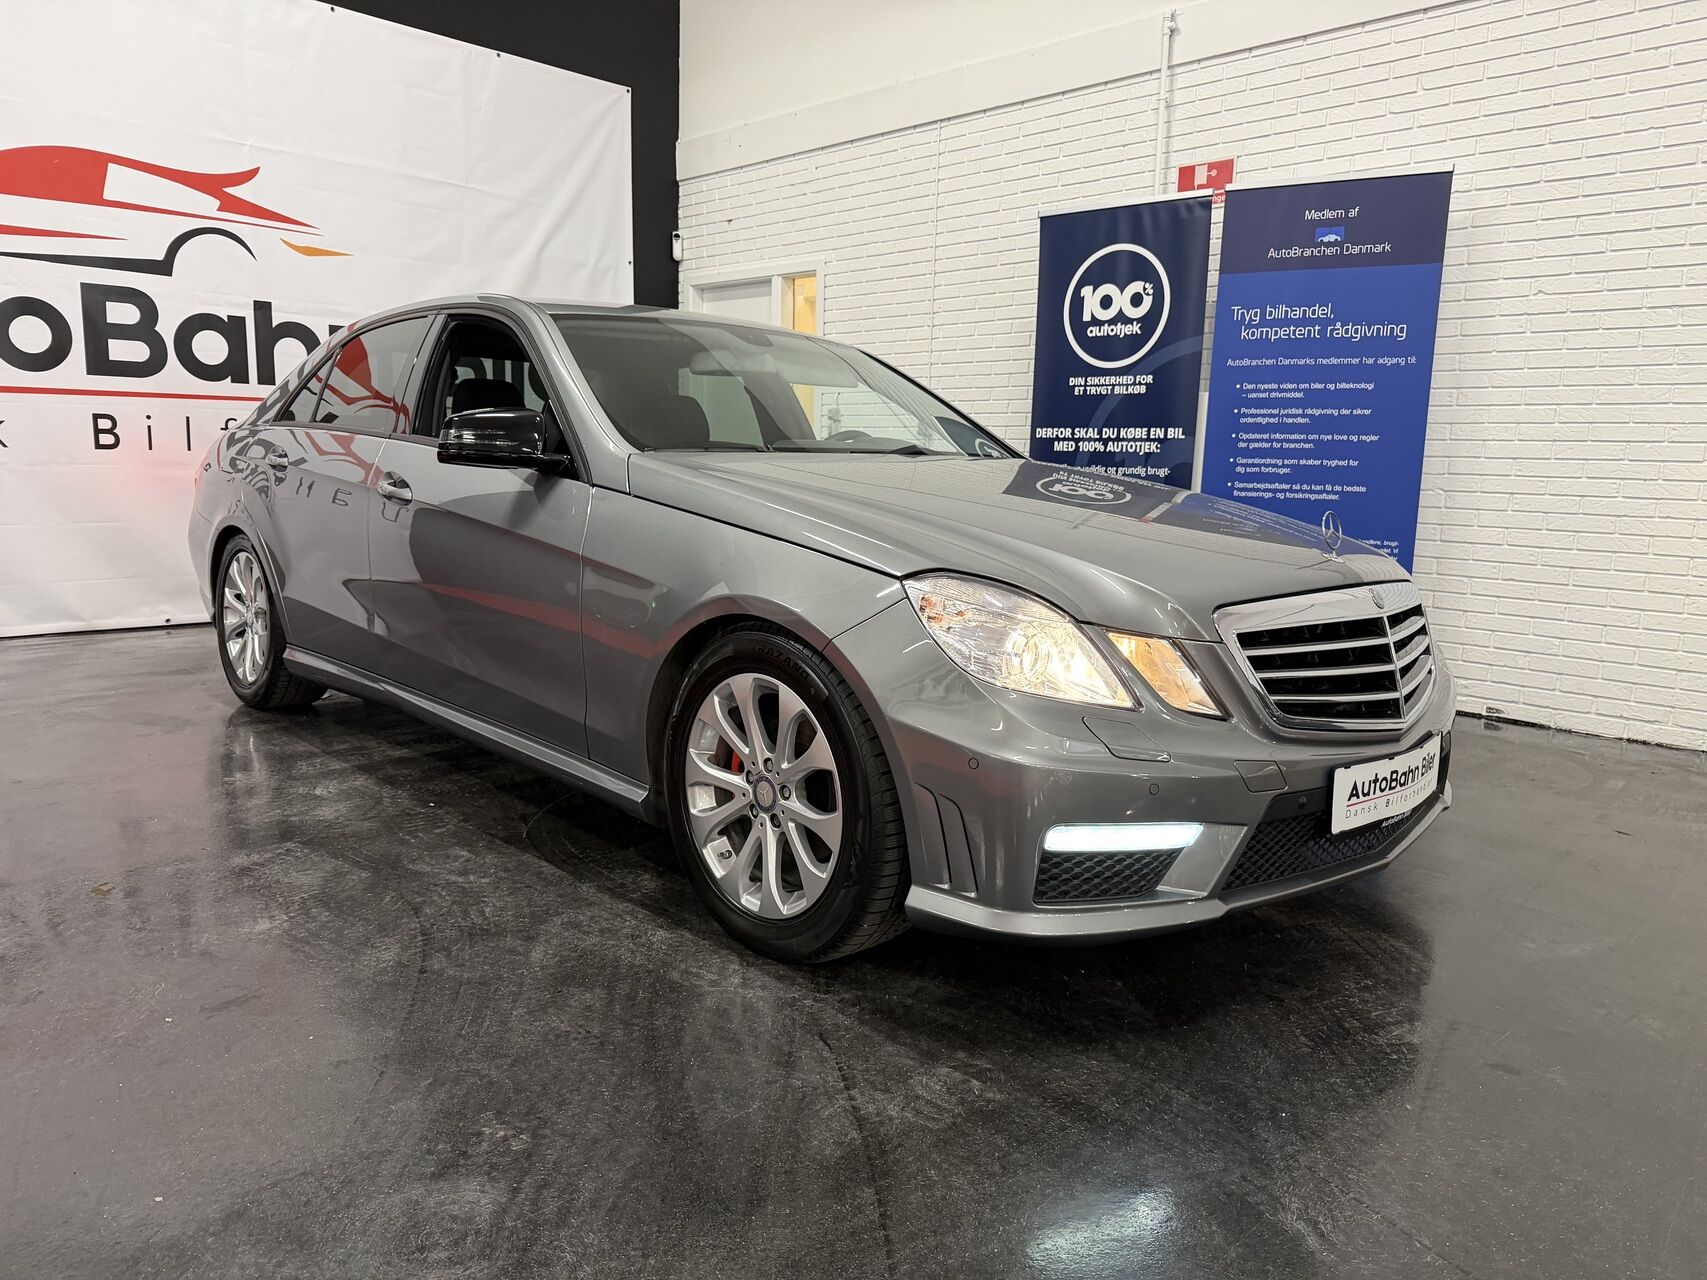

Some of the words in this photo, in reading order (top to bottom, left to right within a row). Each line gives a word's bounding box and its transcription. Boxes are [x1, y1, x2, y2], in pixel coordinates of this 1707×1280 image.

[1304, 208, 1345, 220] Medlem
[1348, 206, 1359, 218] af
[1267, 244, 1340, 259] AutoBranchen
[1343, 242, 1392, 255] Danmark
[1231, 306, 1260, 324] Tryg
[1266, 303, 1334, 321] bilhandel,
[0, 281, 345, 386] oBah
[1087, 321, 1142, 338] autotjek
[1241, 324, 1320, 342] kompetent
[1327, 321, 1407, 342] rådgivning
[1226, 357, 1276, 367] AutoBranchen
[1277, 356, 1315, 366] Danmarks
[1316, 356, 1361, 366] medlemmer
[1362, 356, 1375, 365] har
[1377, 355, 1406, 366] adgang
[1069, 376, 1085, 386] DIN
[1086, 375, 1134, 386] SIKKERHED
[1135, 374, 1153, 384] FOR
[1074, 386, 1085, 396] ET
[1086, 386, 1112, 395] TRYGT
[1114, 385, 1146, 395] BILKØB
[1243, 382, 1256, 390] Den
[1257, 382, 1278, 391] nyeste
[1279, 382, 1297, 390] viden
[1310, 382, 1325, 390] biler
[1326, 383, 1335, 391] og
[1336, 382, 1375, 391] bilteknologi
[1269, 391, 1305, 399] drivmiddel.
[1240, 407, 1279, 416] Professionel
[1280, 407, 1303, 416] juridisk
[1304, 407, 1339, 417] rådgivning
[1239, 416, 1278, 425] ordentlighed
[1282, 416, 1311, 424] handlen.
[1036, 428, 1072, 439] DERFOR
[1073, 427, 1100, 439] SKAL
[1102, 427, 1117, 439] DU
[1120, 427, 1147, 439] KØBE
[1149, 427, 1164, 439] EN
[1167, 427, 1185, 439] BIL
[1238, 432, 1269, 441] Opdateret
[1270, 432, 1306, 441] information
[1320, 434, 1332, 442] nye
[1333, 433, 1348, 441] love
[1359, 433, 1380, 442] regler
[1053, 441, 1075, 452] MED
[1077, 441, 1104, 452] 100%
[1106, 441, 1161, 455] AUTOTJEK:
[1248, 441, 1272, 449] gælder
[1272, 441, 1282, 449] for
[1236, 457, 1283, 466] Garantiordning
[1299, 458, 1322, 466] skaber
[1322, 458, 1348, 467] tryghed
[1107, 467, 1116, 476] og
[1117, 466, 1146, 478] grundig
[1147, 466, 1171, 478] brugt-
[1235, 466, 1245, 474] dig
[1260, 466, 1291, 475] forbruger.
[1233, 481, 1291, 490] Samarbejdsaftaler
[1292, 482, 1300, 490] så
[1301, 483, 1310, 491] du
[1311, 483, 1324, 491] kan
[1324, 483, 1332, 491] få
[1233, 490, 1275, 499] finansierings-
[1285, 491, 1340, 500] forsikringsaftaler.
[1347, 765, 1420, 802] AutoBahn
[1420, 751, 1436, 778] Biler
[1345, 802, 1378, 819] Dansk
